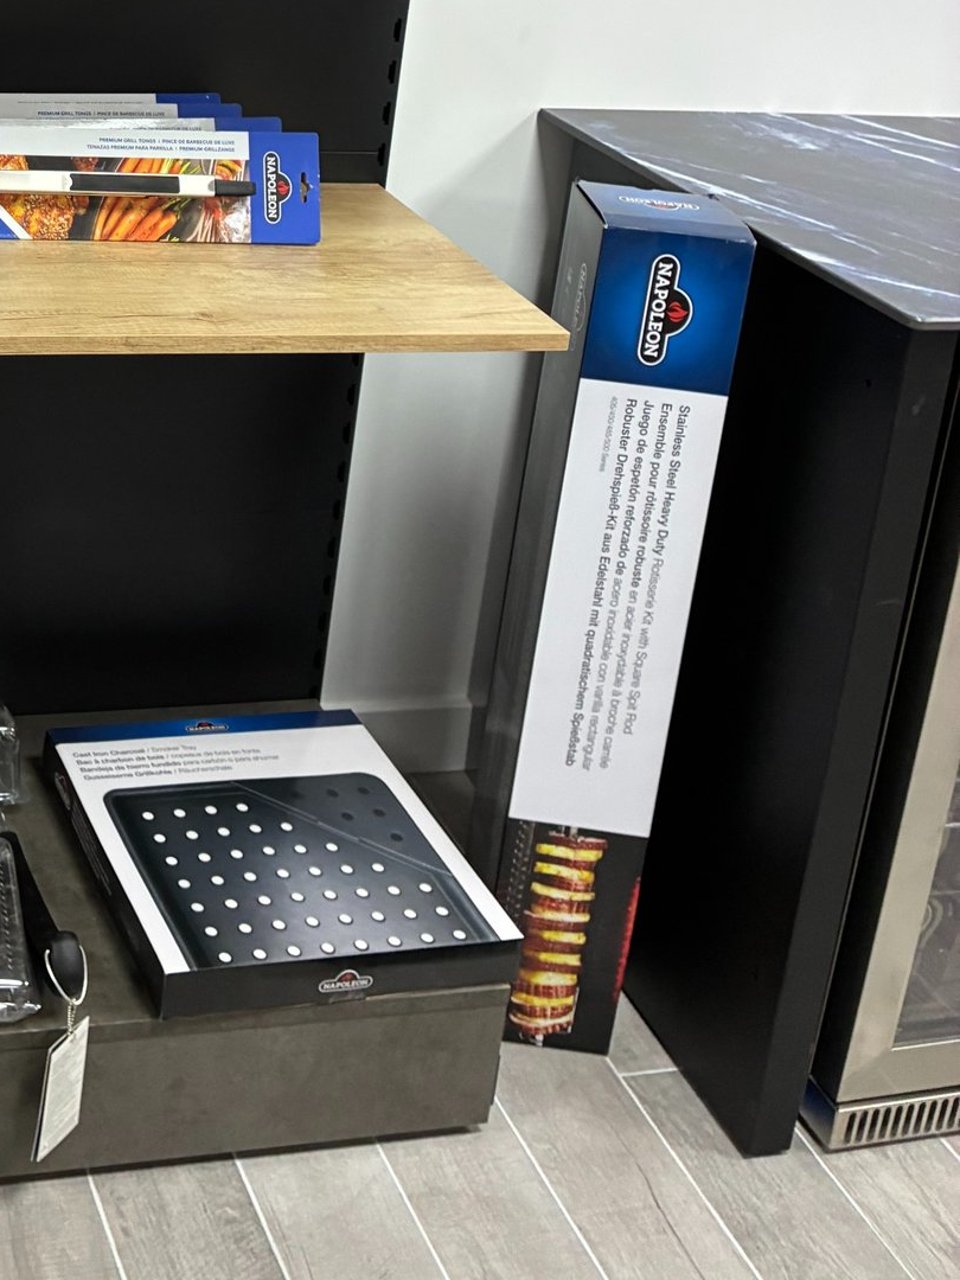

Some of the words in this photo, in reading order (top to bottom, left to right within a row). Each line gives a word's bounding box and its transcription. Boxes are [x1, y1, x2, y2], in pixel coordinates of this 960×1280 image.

[266, 156, 277, 219] NAPOLEON
[644, 262, 674, 358] NAPOLEON
[618, 398, 637, 451] Robuster
[637, 400, 654, 436] Juego
[653, 403, 672, 459] Ensemble
[672, 405, 691, 456] Stainless
[635, 439, 648, 454] de
[605, 454, 628, 530] Drehspieß-Kit
[627, 457, 642, 502] espetón
[647, 462, 659, 488] pour
[666, 460, 681, 489] Steel
[638, 491, 656, 542] rôtissoire
[657, 491, 676, 526] Heavy
[601, 533, 612, 553] aus
[618, 505, 635, 558] reforzado
[652, 529, 669, 555] Duty
[592, 556, 611, 607] Edelstahl
[615, 561, 627, 575] de
[631, 545, 646, 588] robuste
[645, 558, 664, 609] Rotisserie
[628, 590, 638, 603] en
[589, 609, 600, 627] mit
[601, 609, 620, 660] inoxidable
[623, 605, 636, 631] acier
[642, 611, 655, 625] Kit
[638, 628, 651, 649] with
[575, 630, 596, 710] quadratischem
[597, 662, 608, 682] con
[614, 633, 633, 687] inoxydable
[631, 651, 648, 688] Square
[592, 685, 605, 713] varilla
[606, 699, 622, 734] broche
[626, 690, 641, 711] Spit
[565, 713, 584, 767] Spießstab
[623, 713, 637, 735] Rod
[582, 715, 599, 771] rectangular
[324, 978, 370, 990] NAPOLEON
